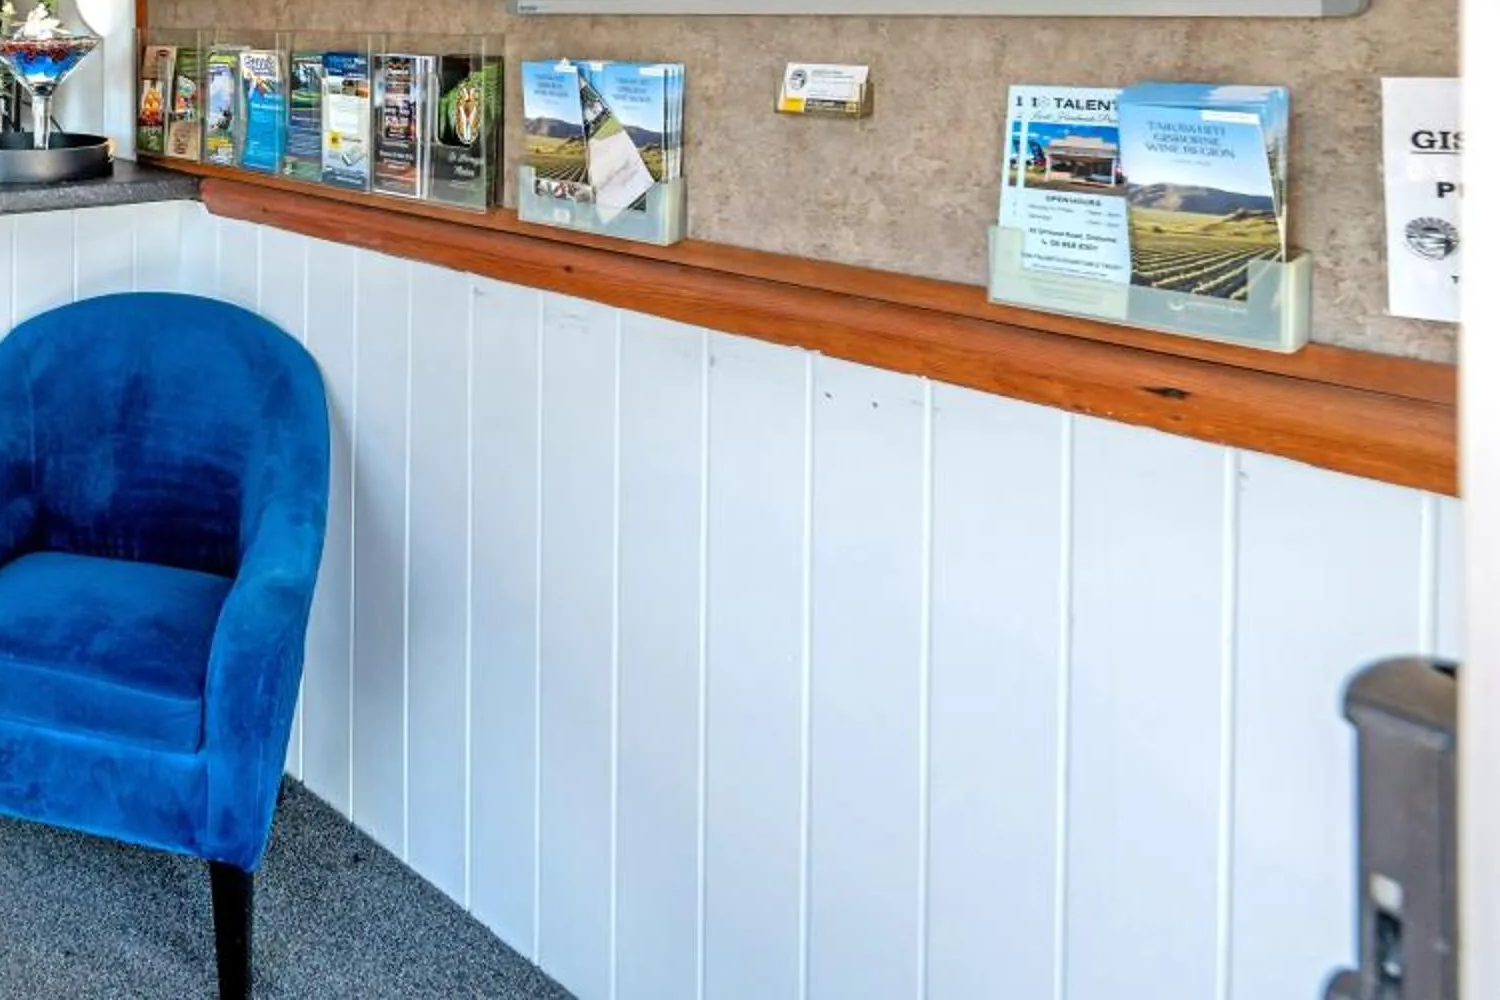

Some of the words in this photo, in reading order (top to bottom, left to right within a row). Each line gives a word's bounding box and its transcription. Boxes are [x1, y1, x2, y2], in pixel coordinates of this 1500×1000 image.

[1152, 132, 1221, 146] GISBORNE
[1144, 142, 1183, 155] WINE
[1184, 144, 1237, 160] REGION
